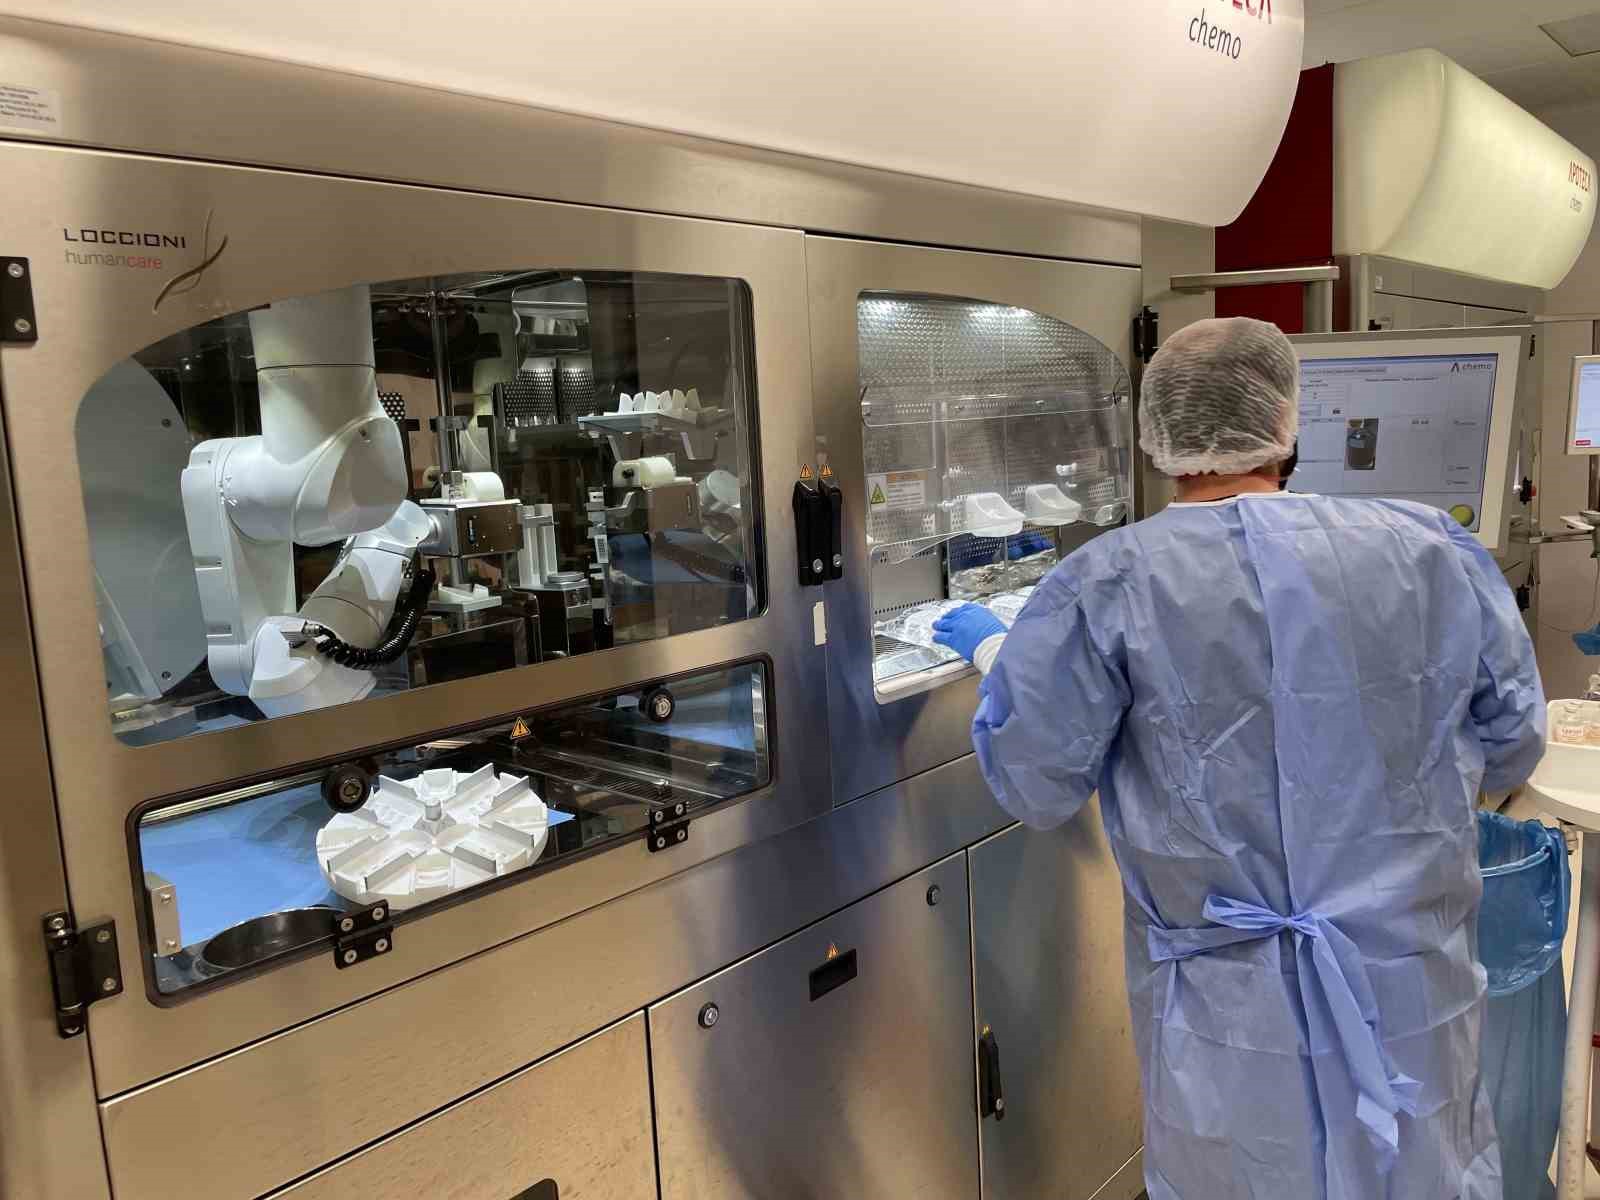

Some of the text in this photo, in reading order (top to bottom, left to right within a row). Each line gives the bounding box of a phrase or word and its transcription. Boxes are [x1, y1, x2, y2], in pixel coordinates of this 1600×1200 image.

[1188, 8, 1242, 60] chemo
[64, 228, 187, 249] LOCCIONI
[65, 249, 162, 270] humancare
